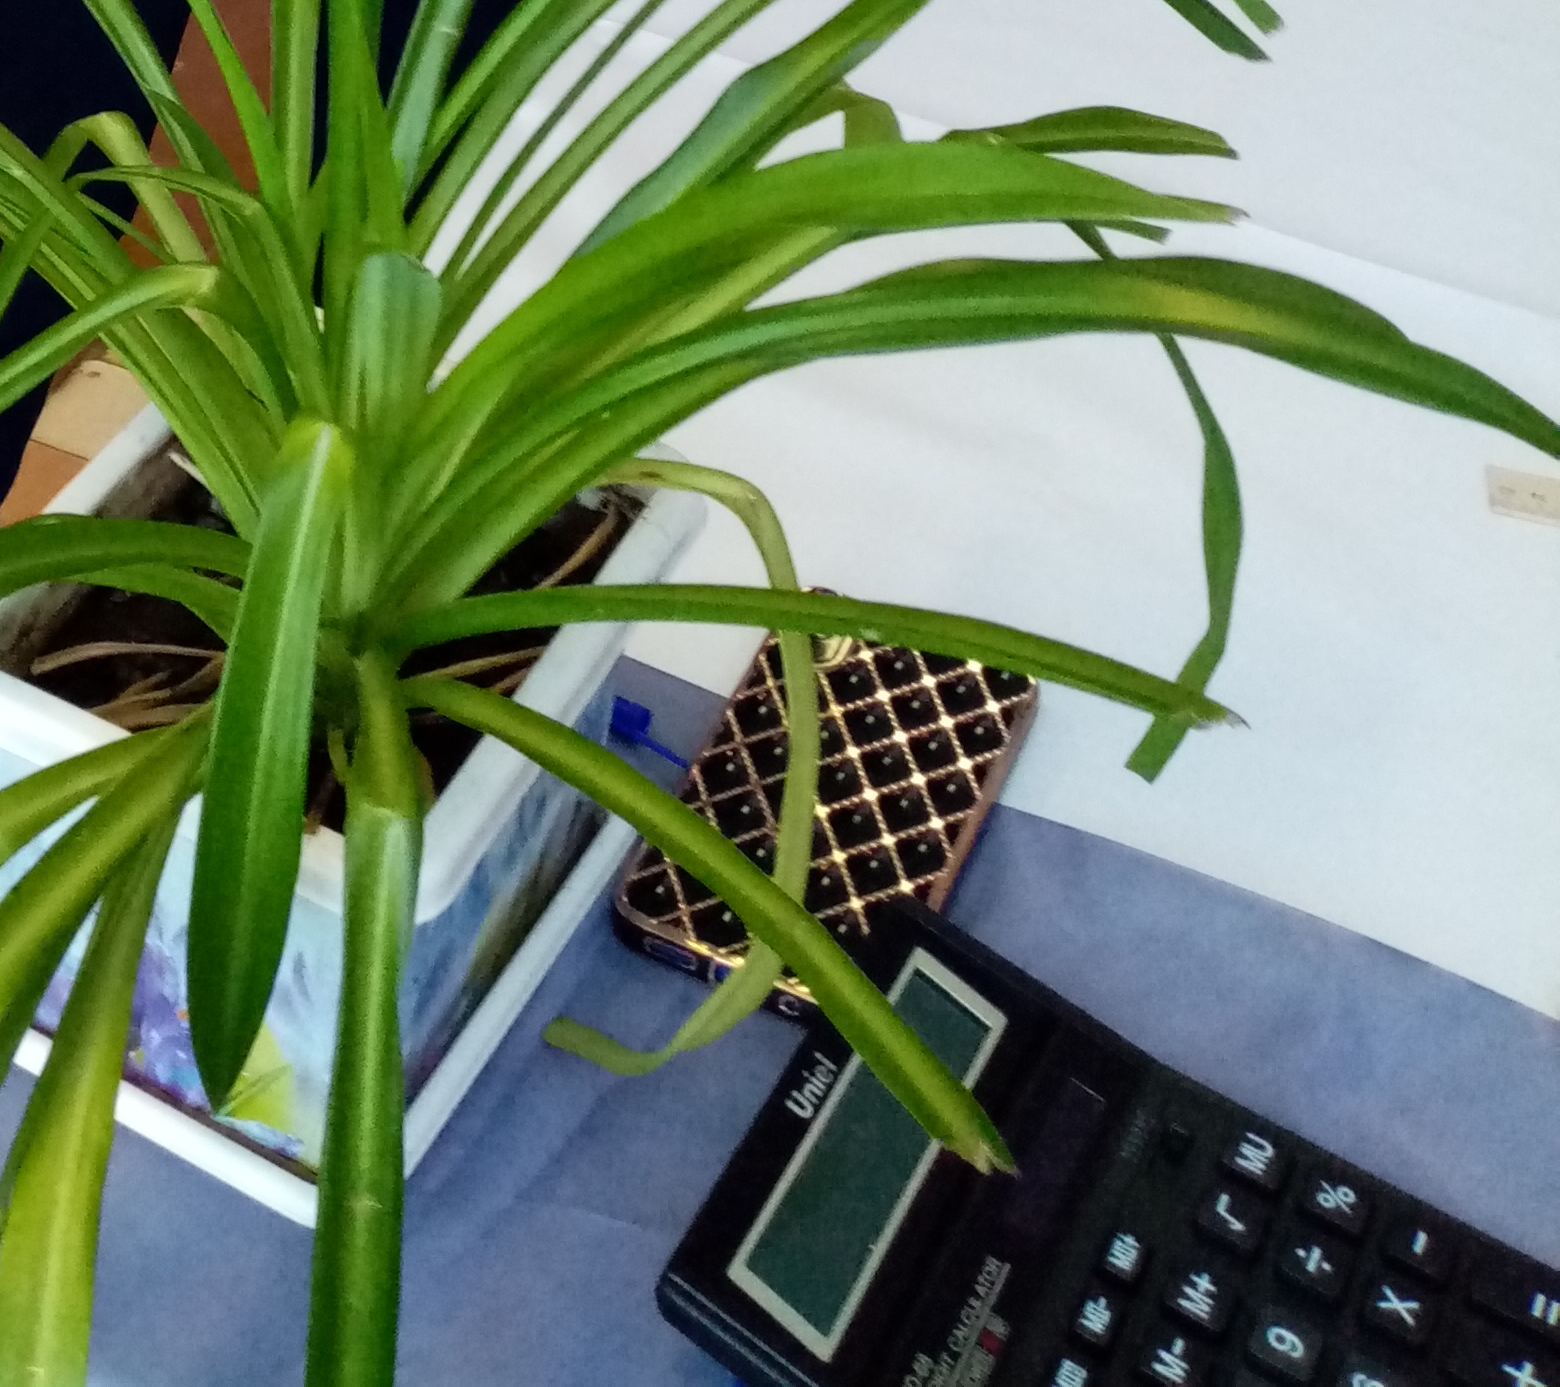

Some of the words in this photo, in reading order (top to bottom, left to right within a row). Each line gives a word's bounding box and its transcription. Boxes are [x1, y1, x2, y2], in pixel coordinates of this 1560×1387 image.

[783, 1050, 839, 1120] Uniel
[1234, 1131, 1275, 1176] MU
[1176, 1272, 1218, 1321] M+
[1150, 1336, 1190, 1385] M-
[1265, 1326, 1305, 1358] 9
